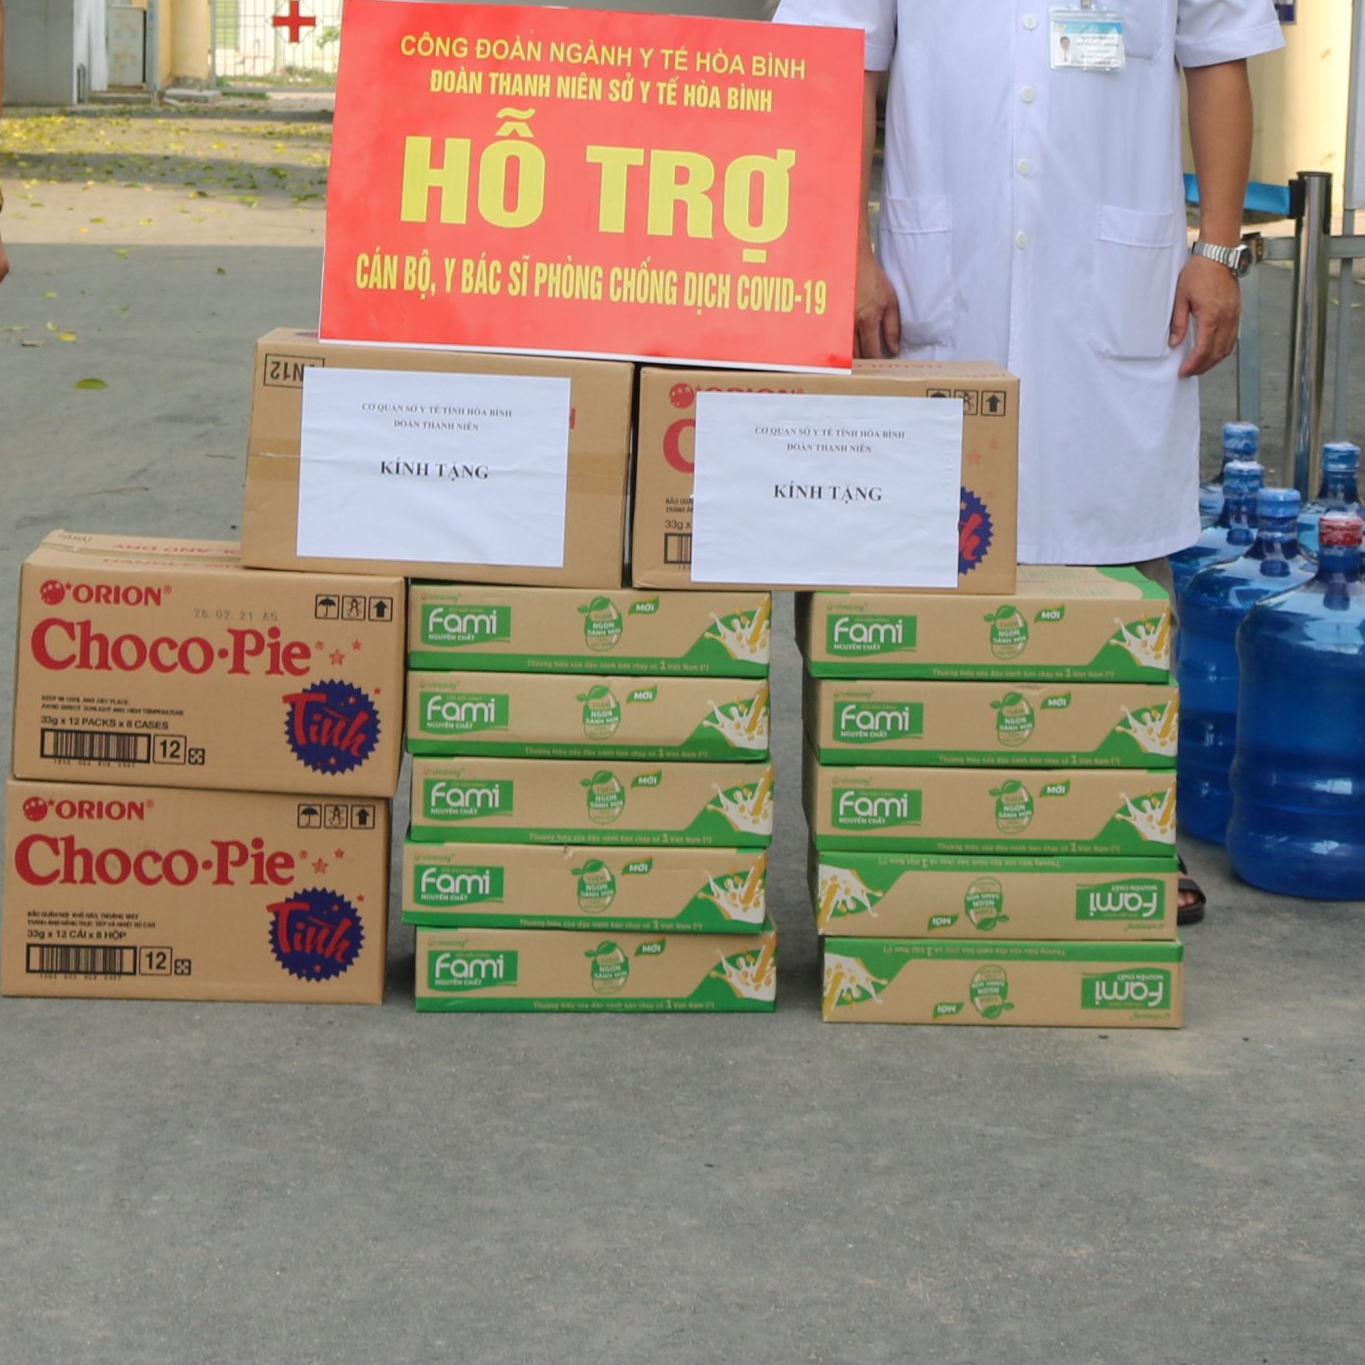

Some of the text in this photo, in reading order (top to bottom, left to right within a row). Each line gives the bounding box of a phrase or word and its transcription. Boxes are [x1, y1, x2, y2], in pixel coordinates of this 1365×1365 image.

[401, 32, 468, 58] CÔNG
[475, 37, 541, 60] ĐOÀN
[550, 43, 632, 65] NGÀNH
[640, 48, 654, 67] Y
[696, 50, 744, 74] HÒA
[752, 55, 805, 77] BÌNH
[430, 67, 772, 111] ĐOÀN THANH NIÊN SỞ Y TẾ HÒA BÌNH
[401, 107, 796, 263] HỖ TRỢ
[356, 247, 827, 315] CÁN BỘ, Y BÁC SĨ PHÒNG CHỐNG DỊCH COVID-19
[377, 403, 403, 413] QUAN
[467, 407, 487, 416] HÒA
[490, 408, 512, 418] BÌNH
[394, 419, 479, 431] ĐOÀN THANH NIÊN
[770, 427, 796, 436] QUAN
[813, 428, 818, 436] Y
[860, 429, 880, 438] HÒA
[882, 430, 905, 439] BÌNH
[787, 443, 872, 453] ĐOÀN THANH NIÊN
[380, 457, 489, 482] KÍNH TẶNG
[773, 480, 883, 505] KÍNH TẶNG
[665, 520, 683, 531] 33g
[41, 716, 58, 725] 33g
[69, 717, 79, 725] 12
[82, 718, 116, 728] PACKS
[135, 721, 168, 730] CASES
[282, 693, 370, 755] Tình
[159, 740, 180, 758] 12
[56, 931, 67, 939] 12
[266, 901, 353, 963] Tình
[145, 951, 166, 970] 12
